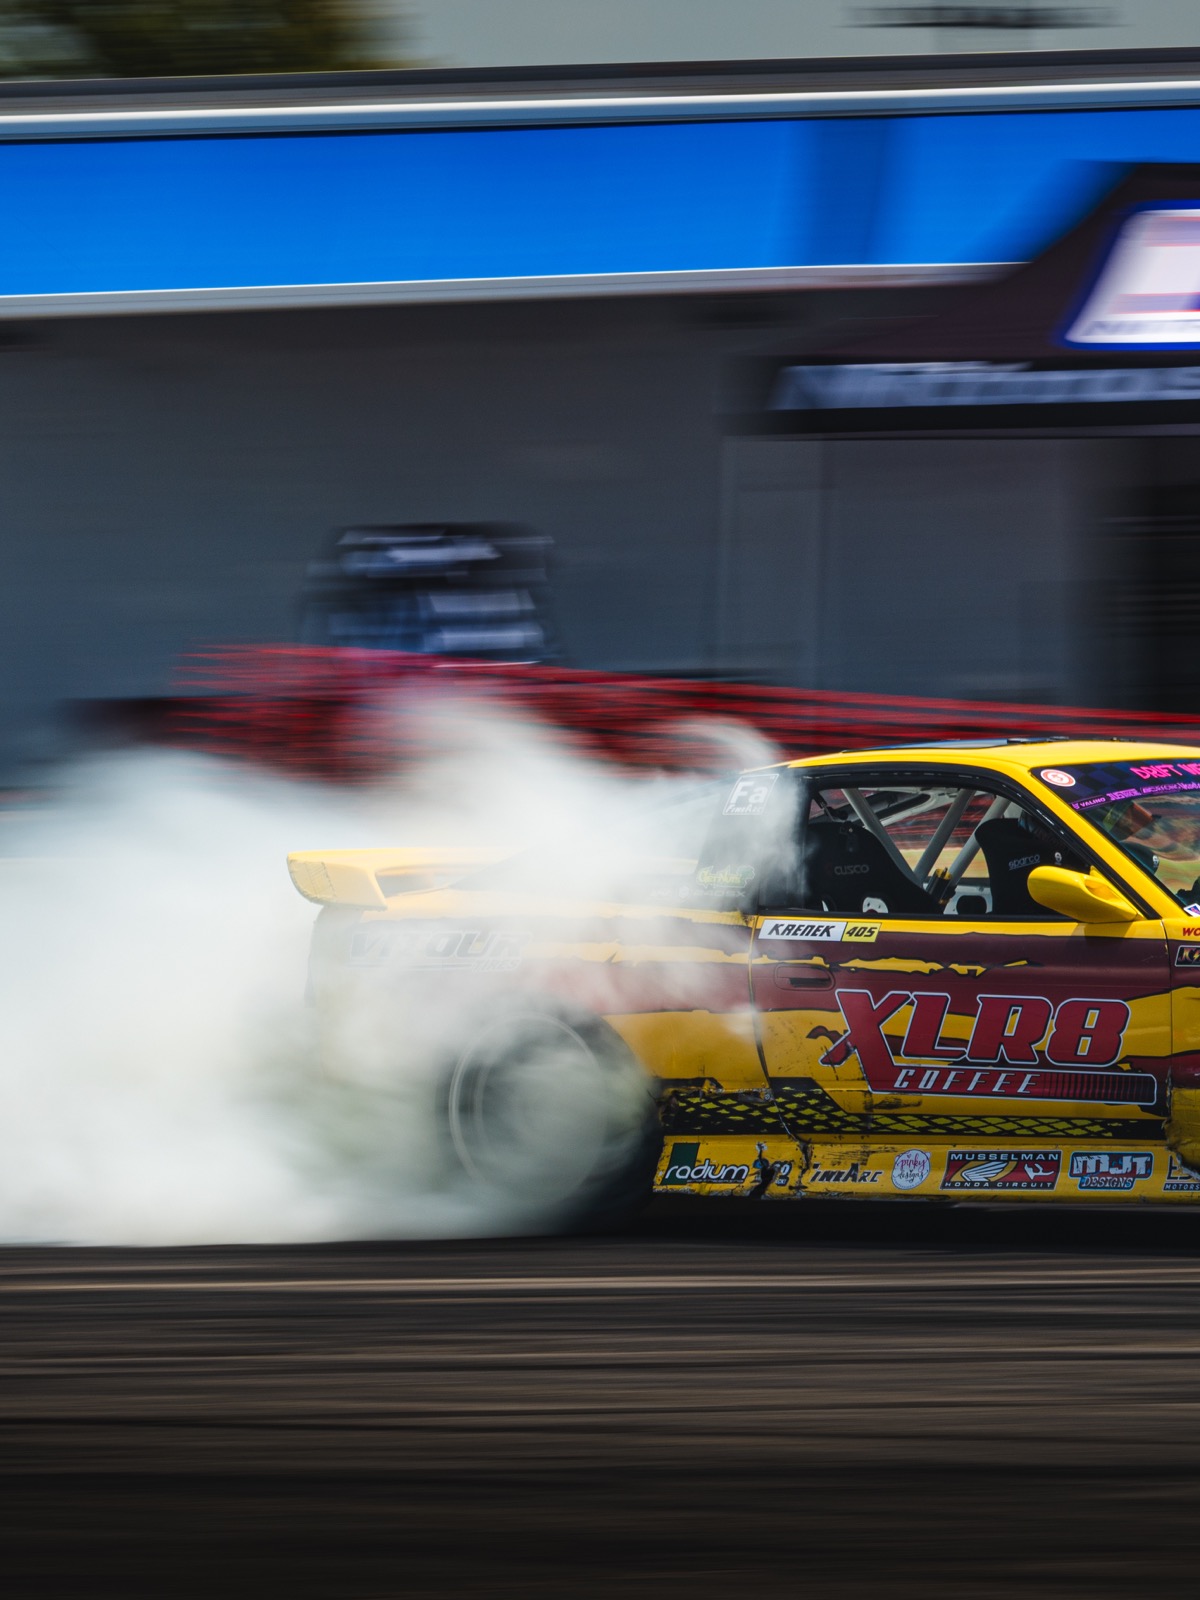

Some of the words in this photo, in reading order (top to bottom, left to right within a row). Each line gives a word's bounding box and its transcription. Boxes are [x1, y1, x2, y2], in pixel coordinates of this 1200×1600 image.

[1130, 764, 1182, 779] DRIFT
[730, 781, 768, 803] Fa
[1009, 854, 1040, 870] sparco
[768, 923, 835, 938] KRENEK
[818, 989, 1132, 1068] XLR8
[894, 1069, 1041, 1094] COFFEE
[665, 1158, 749, 1180] radium
[1081, 1176, 1134, 1188] DESIGNS
